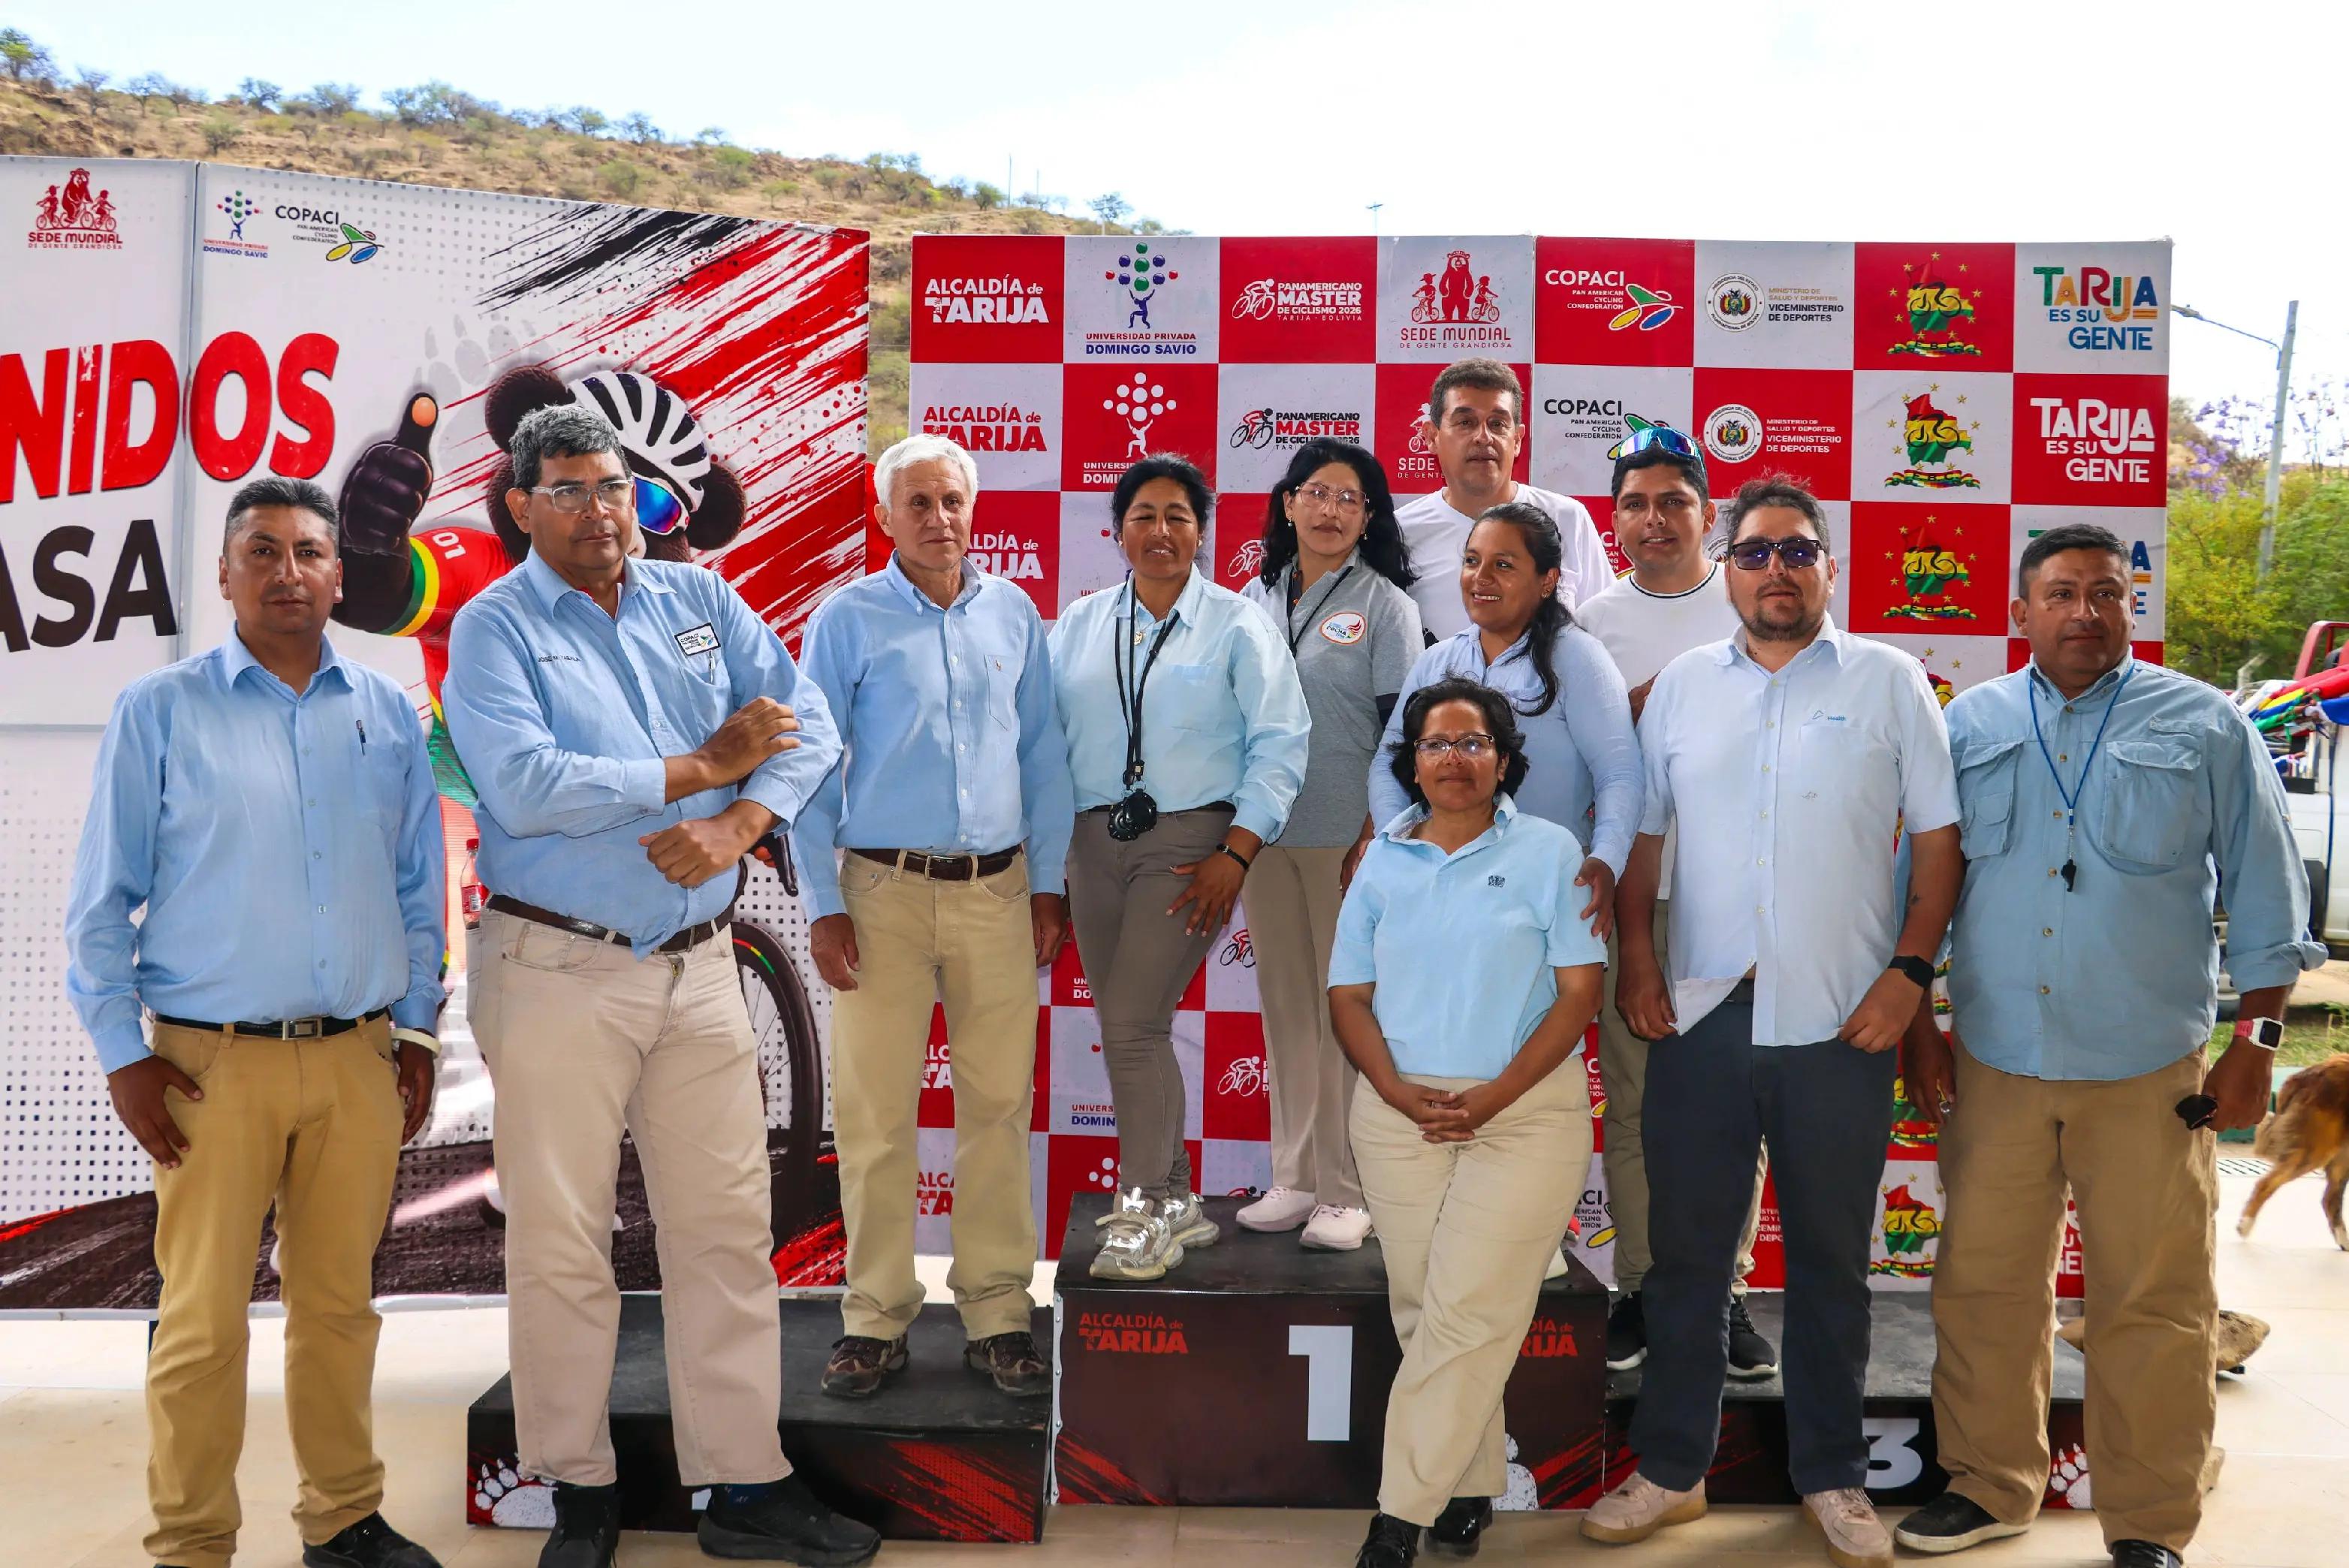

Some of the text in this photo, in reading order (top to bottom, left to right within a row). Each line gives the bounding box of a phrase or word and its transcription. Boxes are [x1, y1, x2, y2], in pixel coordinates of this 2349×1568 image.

[276, 206, 339, 225] COPACI
[29, 232, 122, 244] SEDE MUNDIAL
[204, 246, 268, 258] DOMINGO SAVIO
[925, 273, 1043, 294] ALCALDÍA de
[1545, 270, 1624, 287] COPACI
[1278, 282, 1362, 291] PANAMERICANO
[1277, 291, 1360, 306] MASTER
[2034, 267, 2158, 322] TARIJA
[924, 297, 1049, 323] TARIJA
[1769, 303, 1844, 312] VICEMINISTERIO
[2049, 309, 2100, 323] ES SU
[1401, 327, 1511, 341] SEDE MUNDIAL
[2069, 327, 2152, 350] GENTE
[1086, 344, 1196, 354] DOMINGO SAVIO
[924, 403, 1041, 423] ALCALDÍA de
[1544, 400, 1622, 416] COPACI
[1276, 412, 1360, 421] PANAMERICANO
[1275, 421, 1359, 436] MASTER
[2030, 398, 2155, 454] TARIJA
[2046, 441, 2097, 454] ES SU
[1398, 457, 1434, 470] SEDE
[2066, 460, 2149, 482] GENTE
[1083, 473, 1122, 484] DOMI
[1023, 539, 1039, 550] de
[967, 553, 1044, 580] RIJA
[1072, 1116, 1116, 1126] DOMIN
[1080, 1312, 1184, 1329] ALCALDÍA de
[1078, 1328, 1188, 1354] TARIJA
[1289, 1325, 1352, 1441] 1
[1862, 1418, 1922, 1489] 3
